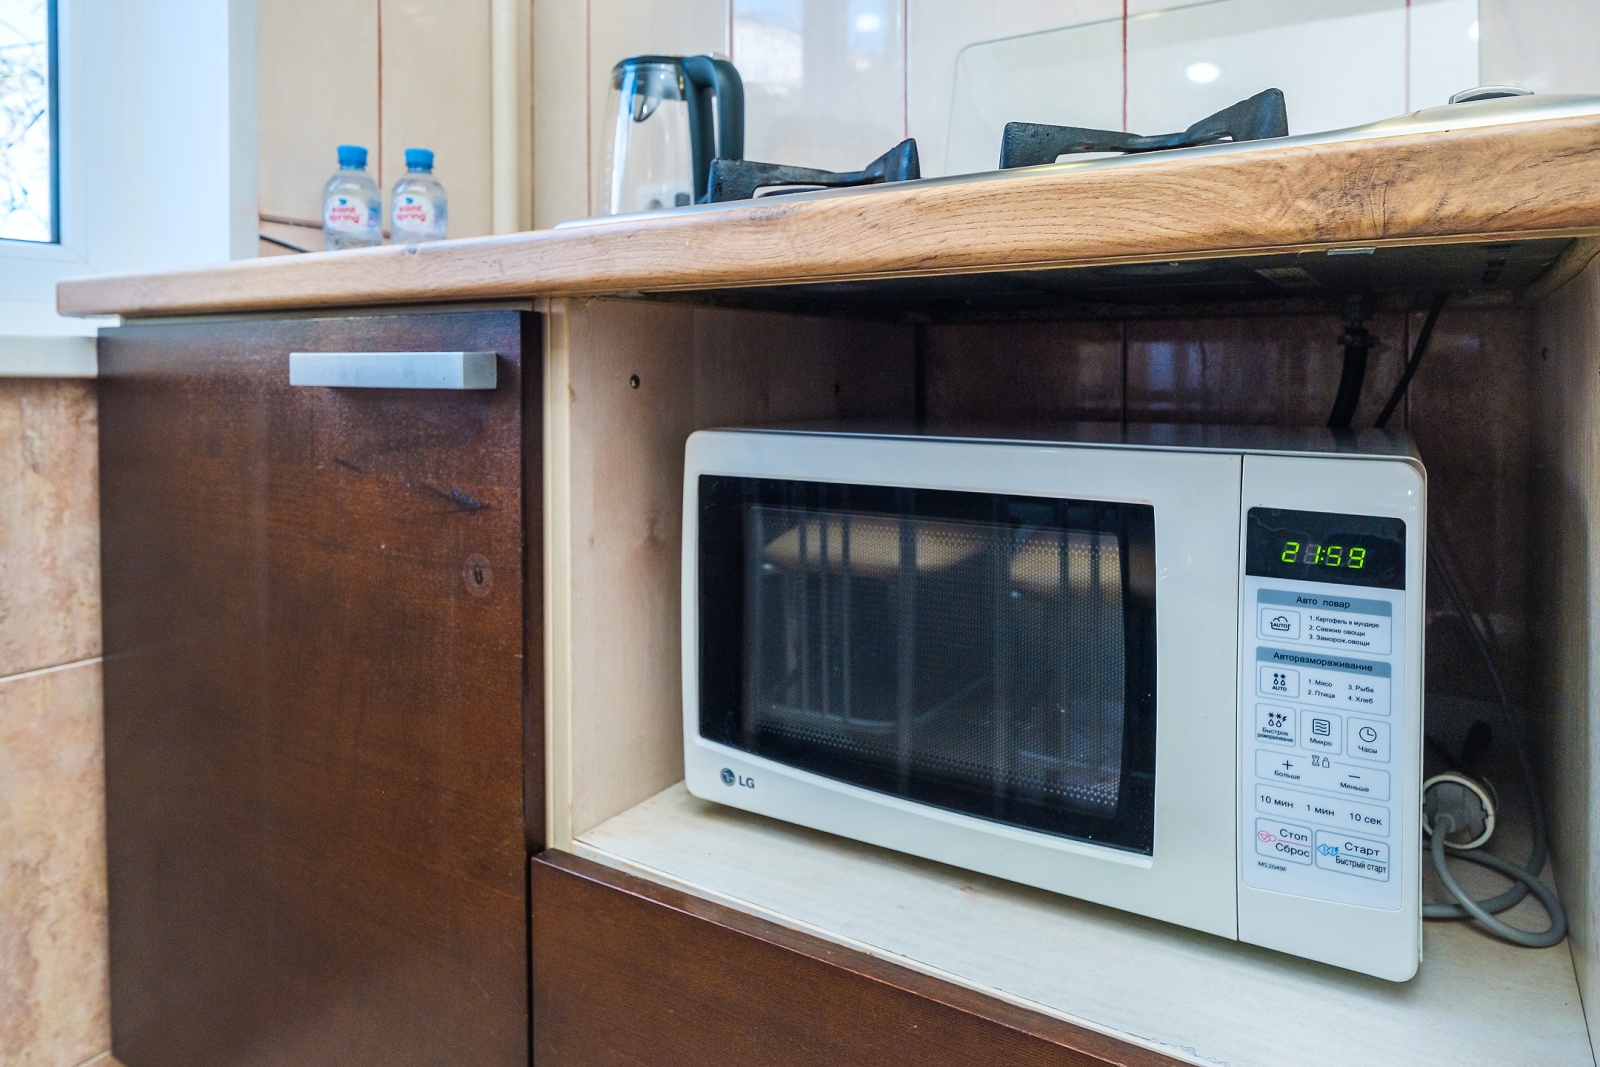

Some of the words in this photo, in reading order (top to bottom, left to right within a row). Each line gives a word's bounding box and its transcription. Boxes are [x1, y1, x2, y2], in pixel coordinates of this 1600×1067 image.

[1281, 541, 1366, 569] 21:59
[1295, 595, 1318, 606] Авто
[1322, 599, 1351, 609] повар
[1315, 616, 1348, 625] Картофель
[1353, 621, 1380, 629] мундире
[1315, 626, 1342, 634] Свежие
[1343, 629, 1366, 637] овощи
[1272, 651, 1374, 672] Авторазмораживание
[1314, 680, 1333, 688] Мясо
[1355, 685, 1374, 694] Рыба
[1314, 690, 1336, 699] Птица
[1355, 696, 1374, 704] Хлеб
[1261, 726, 1289, 737] Быстрое
[1309, 737, 1333, 747] Микро
[1357, 744, 1378, 754] Часы
[1274, 769, 1301, 781] Больше
[738, 775, 755, 789] LG
[1339, 781, 1370, 793] Меньше
[1260, 794, 1272, 804] 10
[1273, 798, 1294, 808] мин
[1314, 806, 1335, 817] мин
[1350, 812, 1362, 822] 10
[1364, 816, 1383, 826] сек
[1279, 828, 1308, 842] Стоп
[1275, 842, 1310, 858] Сброс
[1344, 841, 1381, 857] Старт
[1335, 855, 1366, 869] Быстрый
[1366, 863, 1387, 875] старт
